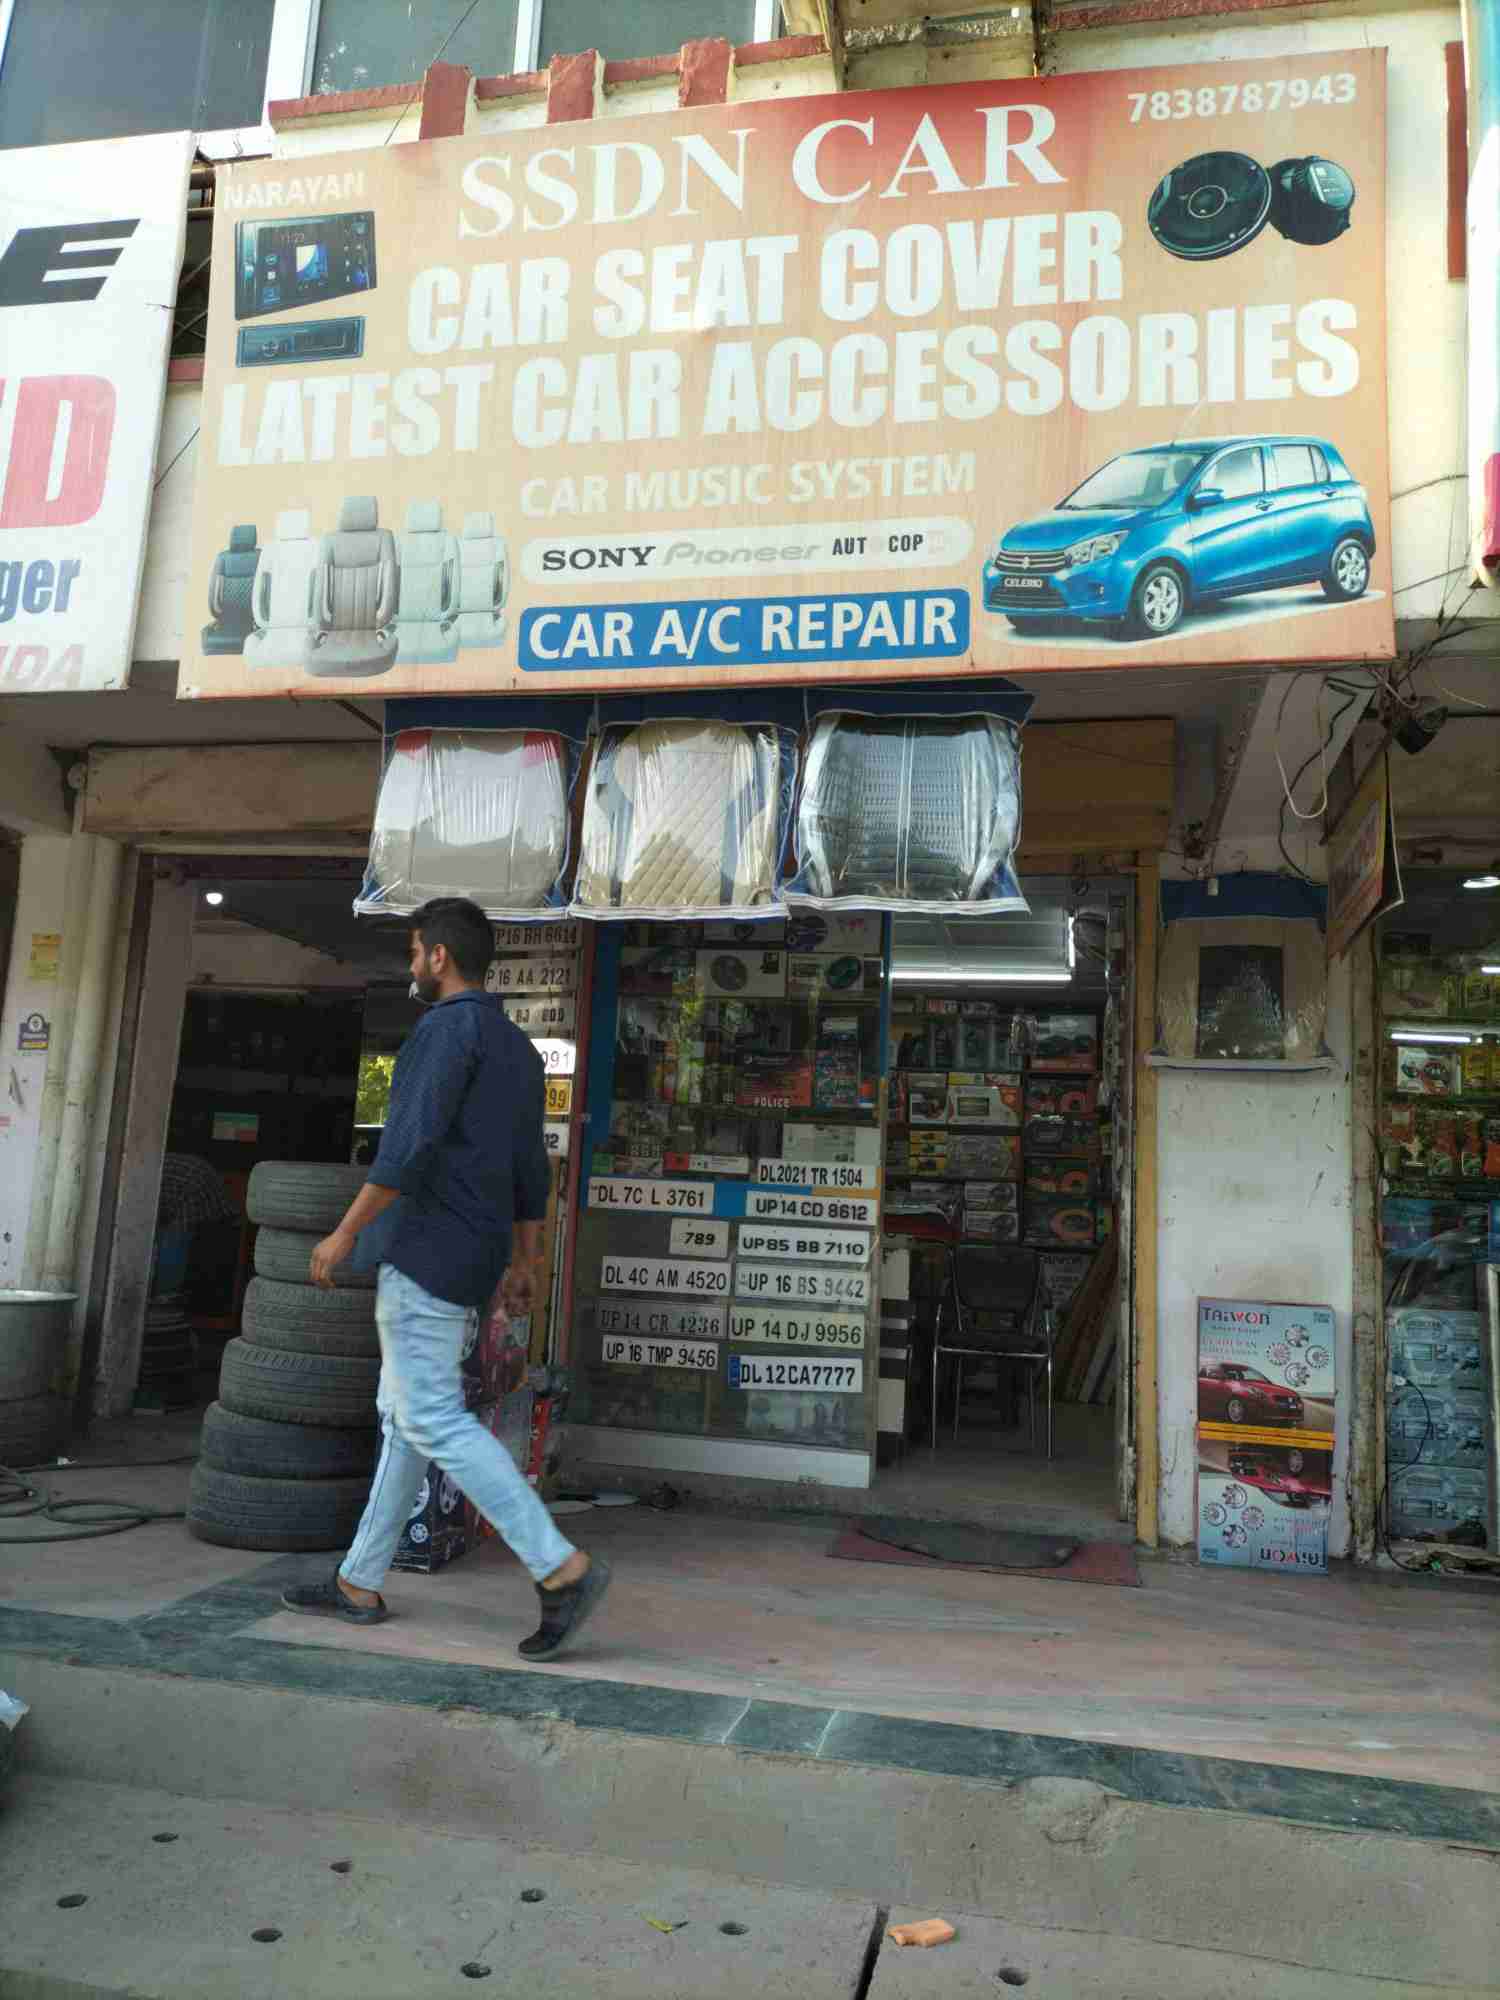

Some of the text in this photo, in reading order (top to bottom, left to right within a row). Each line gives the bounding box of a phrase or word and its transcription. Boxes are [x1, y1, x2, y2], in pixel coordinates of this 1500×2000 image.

[1127, 73, 1357, 122] 7838787943
[457, 104, 1067, 241] SSDN CAR
[224, 171, 367, 209] NARAYAN
[407, 211, 1124, 356] CAR SEAT COVER
[217, 300, 1360, 465] LATEST CAR ACCESSORIES
[519, 451, 976, 518] CAR MUSIC SYSTEM
[541, 545, 656, 571] SONY
[664, 541, 823, 567] Pioneer
[888, 533, 924, 553] COP
[1003, 577, 1042, 589] CELERIO
[528, 597, 957, 660] CAR A/C REPAIR
[753, 1096, 791, 1109] POLICE
[760, 1164, 863, 1186] DL2021 TR 1504
[599, 1184, 618, 1203] DL
[651, 1189, 661, 1205] L
[666, 1189, 705, 1207] 3761
[800, 1201, 823, 1217] CD
[828, 1203, 867, 1220] 8612
[684, 1231, 716, 1246] 789
[796, 1240, 819, 1253] BB
[824, 1241, 864, 1256] 7110
[605, 1265, 727, 1290] DL 4C AM 4520
[748, 1273, 768, 1291] UP
[775, 1274, 791, 1293] 16
[797, 1276, 817, 1295] BS
[601, 1310, 620, 1328] UP
[626, 1312, 640, 1329] 14
[649, 1314, 669, 1331] CR
[731, 1318, 861, 1344] UP 14 DJ 9956
[606, 1342, 624, 1360] UP
[630, 1344, 642, 1362] 16
[678, 1347, 716, 1367] 9456
